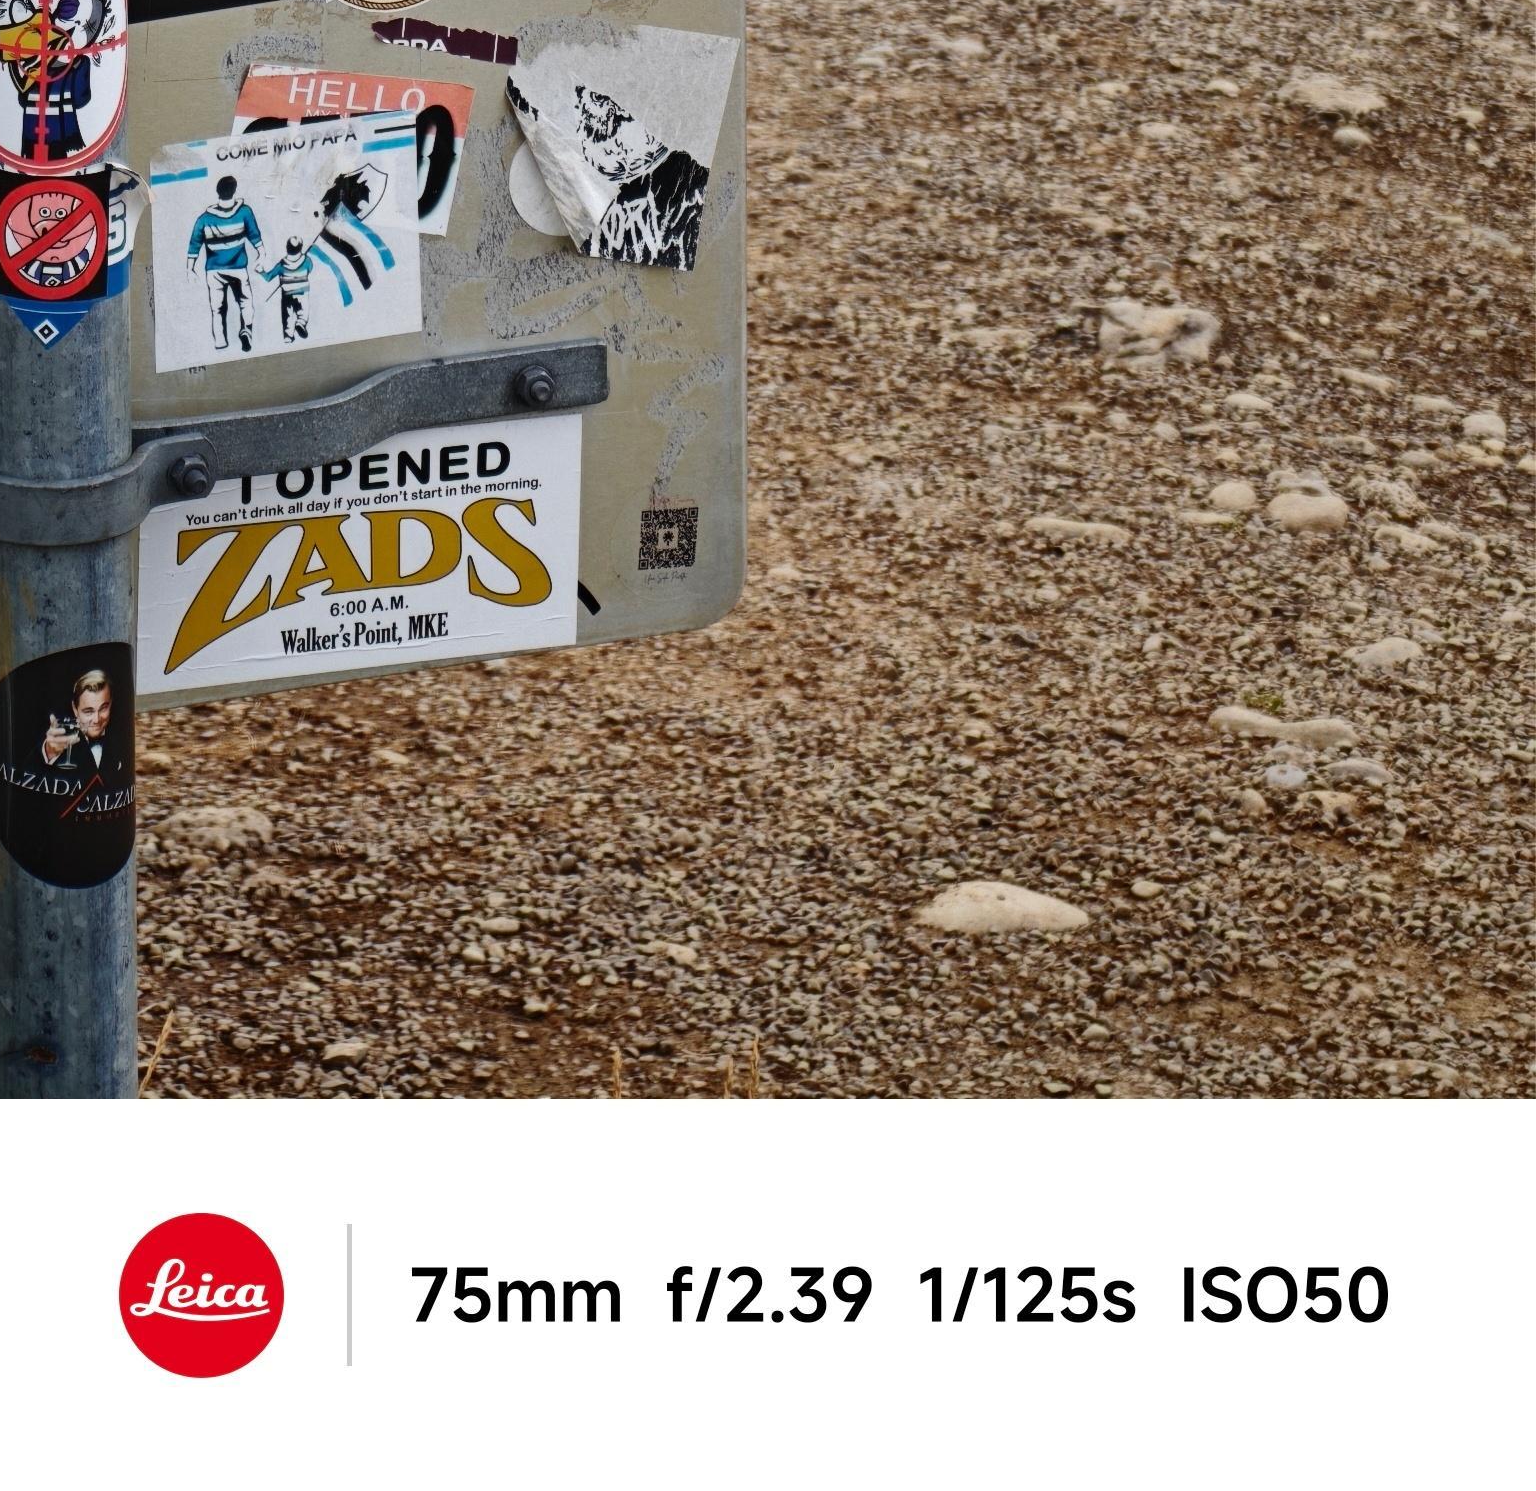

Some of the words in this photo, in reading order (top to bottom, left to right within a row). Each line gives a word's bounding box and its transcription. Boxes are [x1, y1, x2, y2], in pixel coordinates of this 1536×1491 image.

[288, 76, 427, 114] HELLO
[275, 440, 512, 501] OPENED
[185, 512, 210, 527] You
[211, 507, 249, 522] can't
[250, 503, 286, 519] drink
[287, 500, 305, 514] all
[306, 498, 331, 516] day
[332, 496, 344, 511] if
[346, 495, 371, 512] you
[373, 489, 409, 506] don't
[411, 484, 443, 501] start
[445, 483, 458, 497] in
[460, 480, 482, 495] the
[484, 476, 543, 496] morning.
[164, 497, 554, 676] ZADS
[329, 598, 367, 618] 6:00
[370, 594, 410, 614] A.M.
[280, 623, 352, 656] Walker's
[353, 618, 403, 649] Point,
[407, 611, 450, 641] MKE
